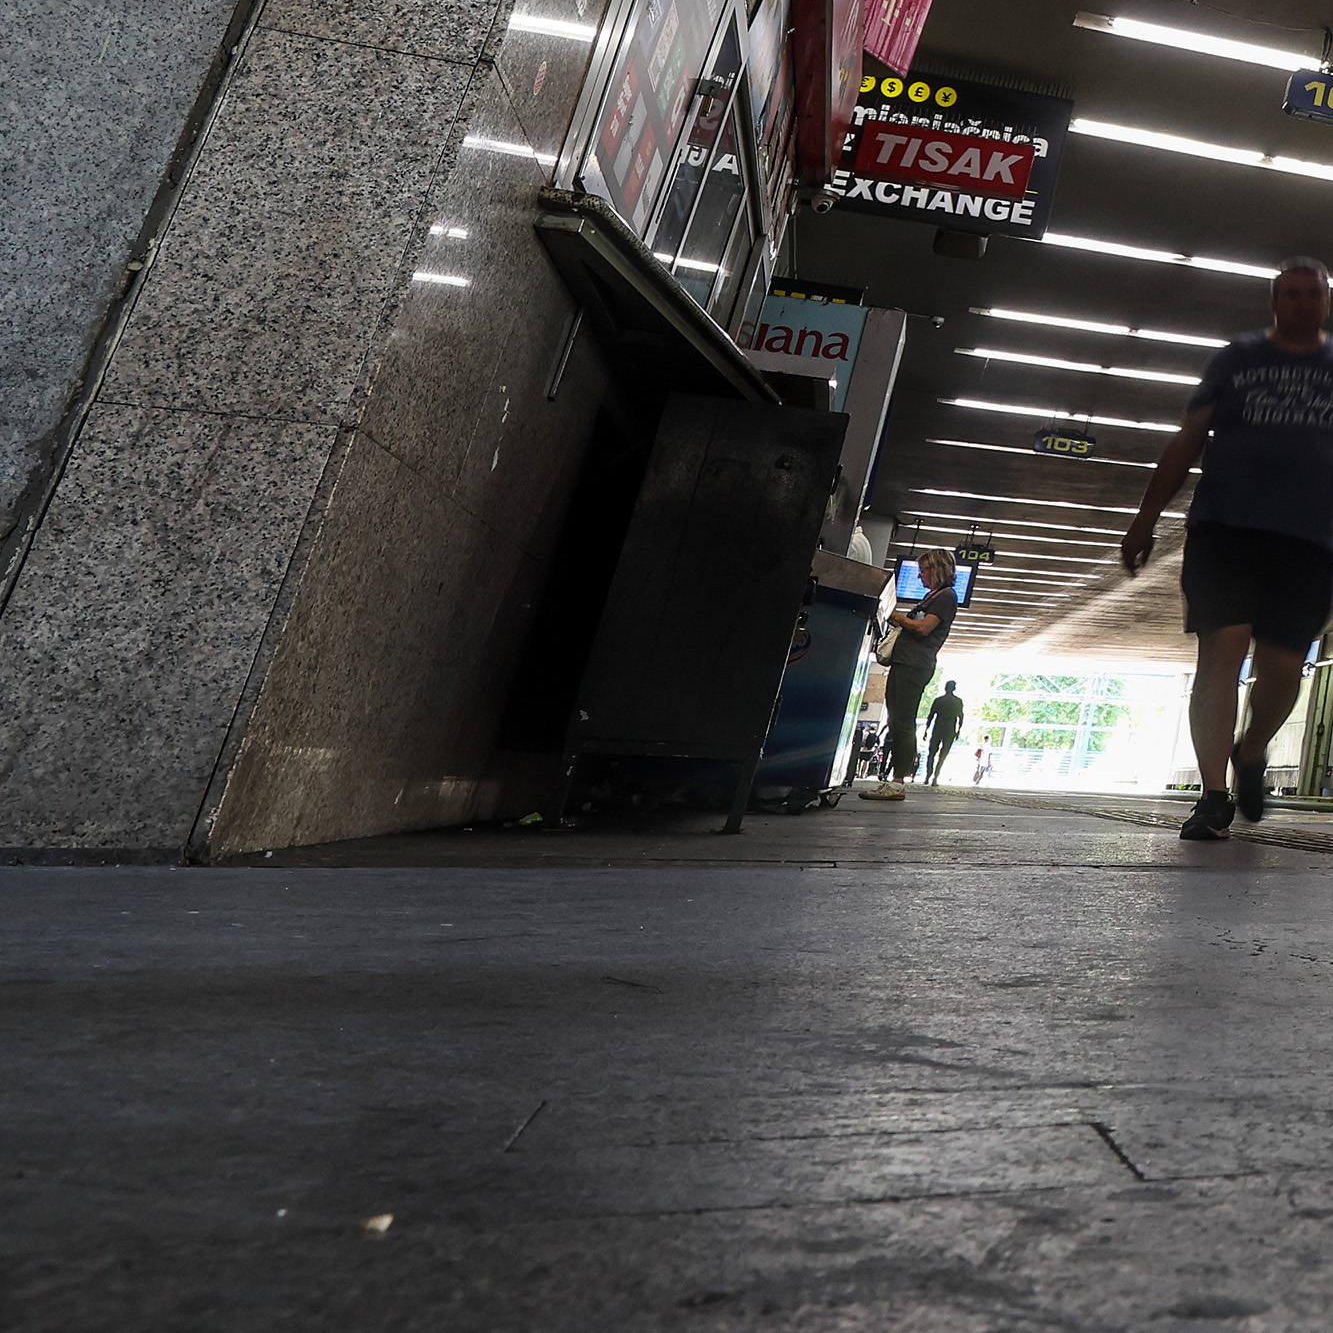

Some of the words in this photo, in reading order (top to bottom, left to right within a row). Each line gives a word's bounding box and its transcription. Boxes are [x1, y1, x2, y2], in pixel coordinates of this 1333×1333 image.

[875, 132, 1024, 185] TISAK
[831, 169, 1036, 226] EXCHANGE
[1041, 436, 1089, 454] 103
[959, 549, 991, 561] 104
